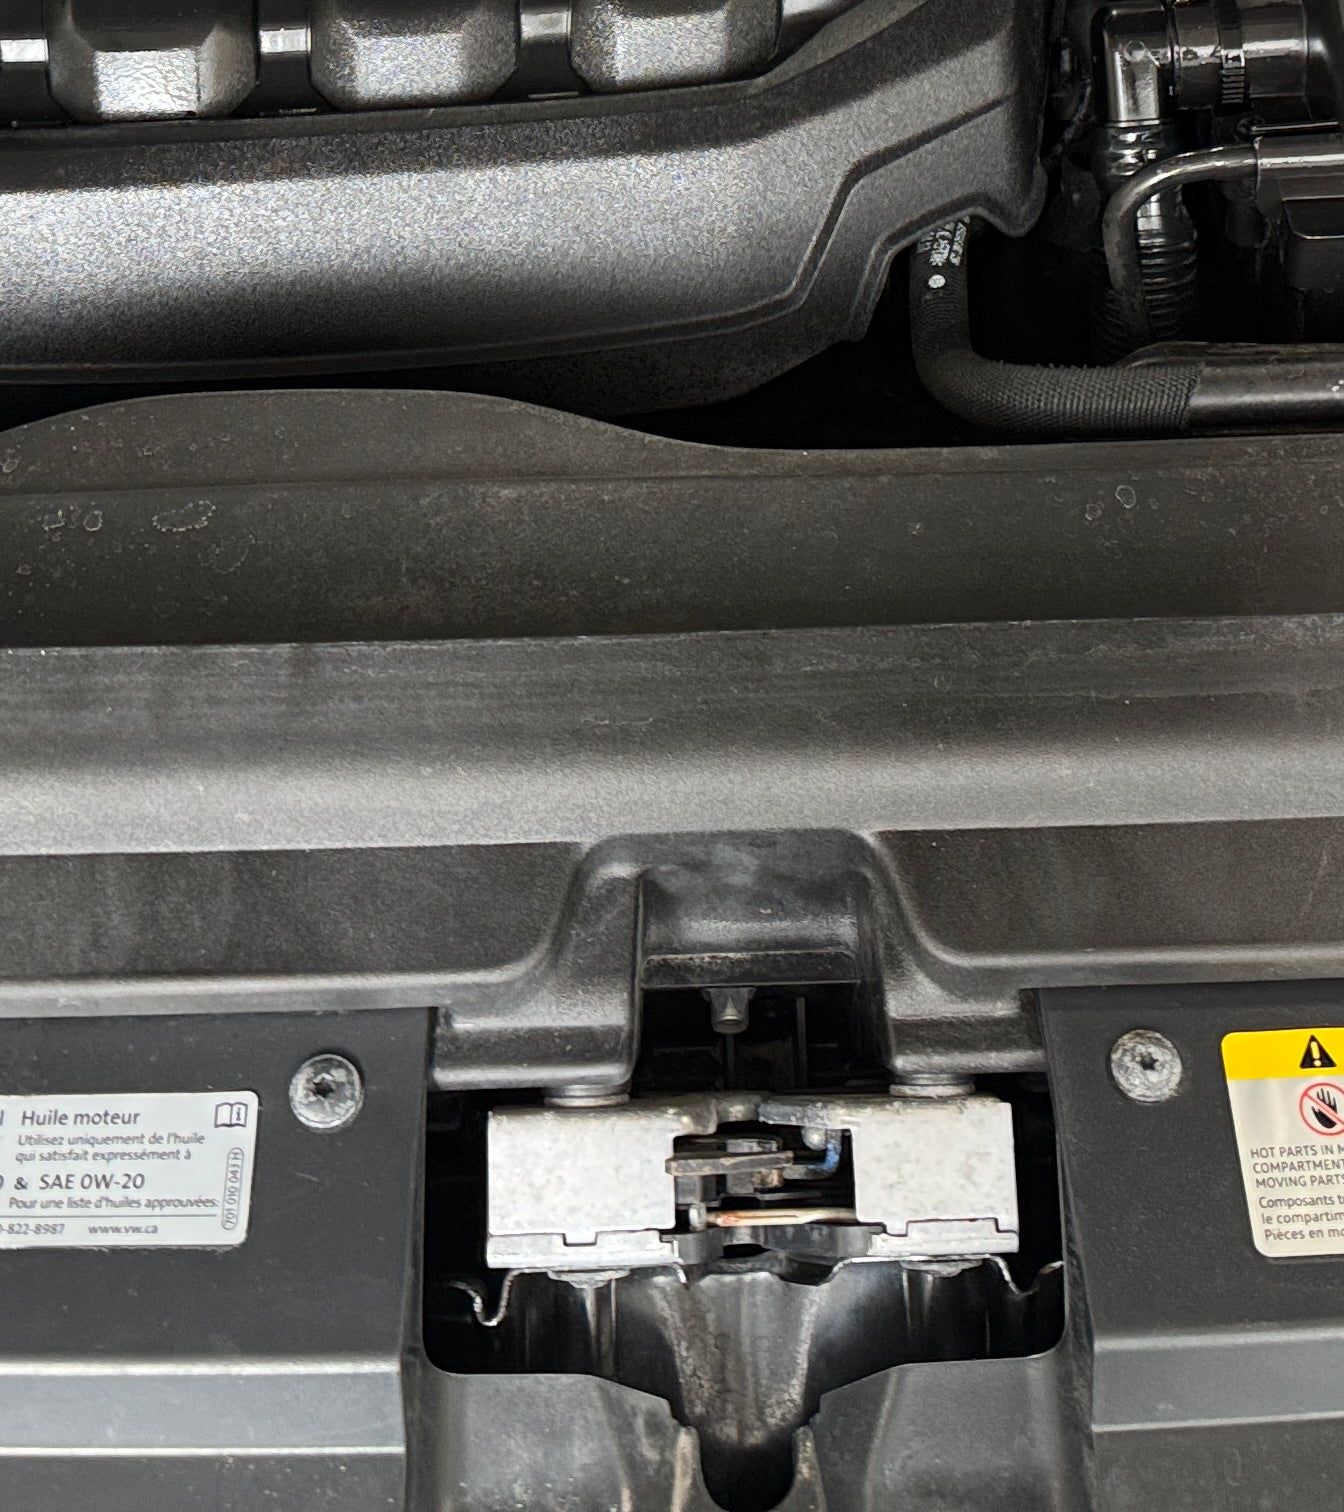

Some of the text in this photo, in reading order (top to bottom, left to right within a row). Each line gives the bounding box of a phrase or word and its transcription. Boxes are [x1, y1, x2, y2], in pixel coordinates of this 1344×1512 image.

[21, 1109, 69, 1126] Huile
[73, 1111, 140, 1125] moteur
[18, 1133, 64, 1146] Utilisez
[68, 1134, 145, 1149] uniquement
[148, 1132, 164, 1145] de
[15, 1150, 35, 1164] qui
[38, 1149, 89, 1162] satisfait
[185, 1149, 192, 1160] à
[1251, 1148, 1278, 1159] HOT
[1279, 1146, 1319, 1157] PARTS
[1321, 1144, 1334, 1155] IN
[13, 1175, 28, 1190] &
[39, 1173, 75, 1190] SAE
[80, 1172, 146, 1190] 0W-20
[1255, 1175, 1308, 1188] MOVING
[9, 1196, 37, 1210] Pour
[40, 1197, 64, 1209] une
[67, 1197, 92, 1209] liste
[1258, 1195, 1335, 1211] Composants
[1261, 1213, 1275, 1225] le
[1264, 1227, 1306, 1240] Pièces
[1308, 1227, 1323, 1238] en
